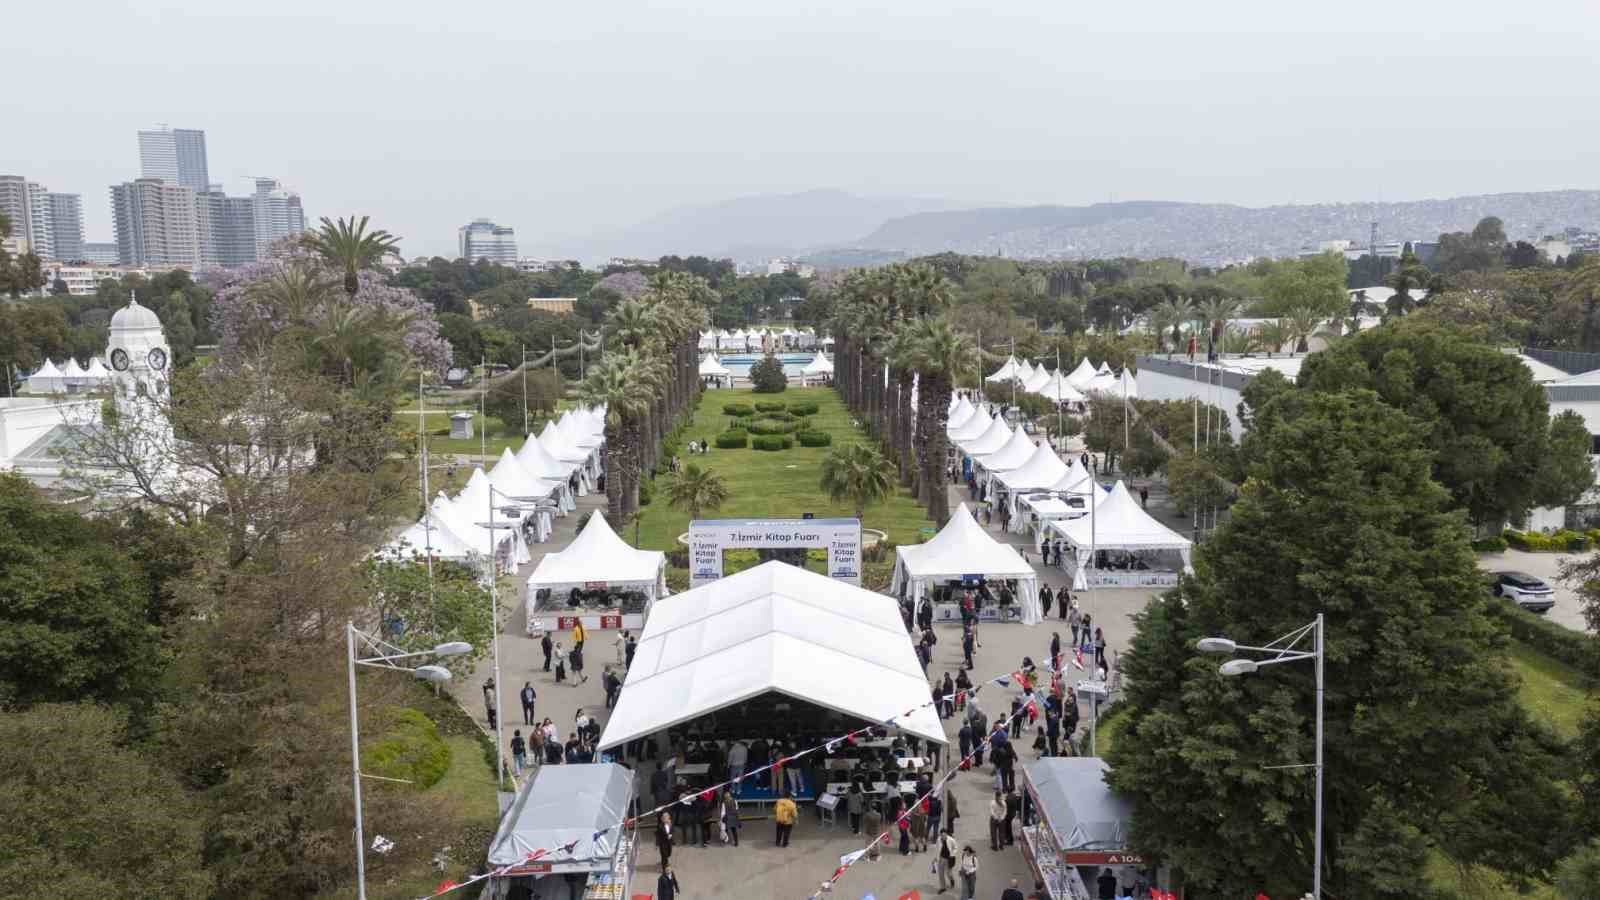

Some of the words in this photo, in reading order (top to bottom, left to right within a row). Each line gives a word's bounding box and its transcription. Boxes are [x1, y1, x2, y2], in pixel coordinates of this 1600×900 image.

[766, 532, 791, 543] Kitap
[794, 532, 819, 542] Fuarı
[695, 550, 715, 558] Kitap
[834, 549, 855, 557] Kitap
